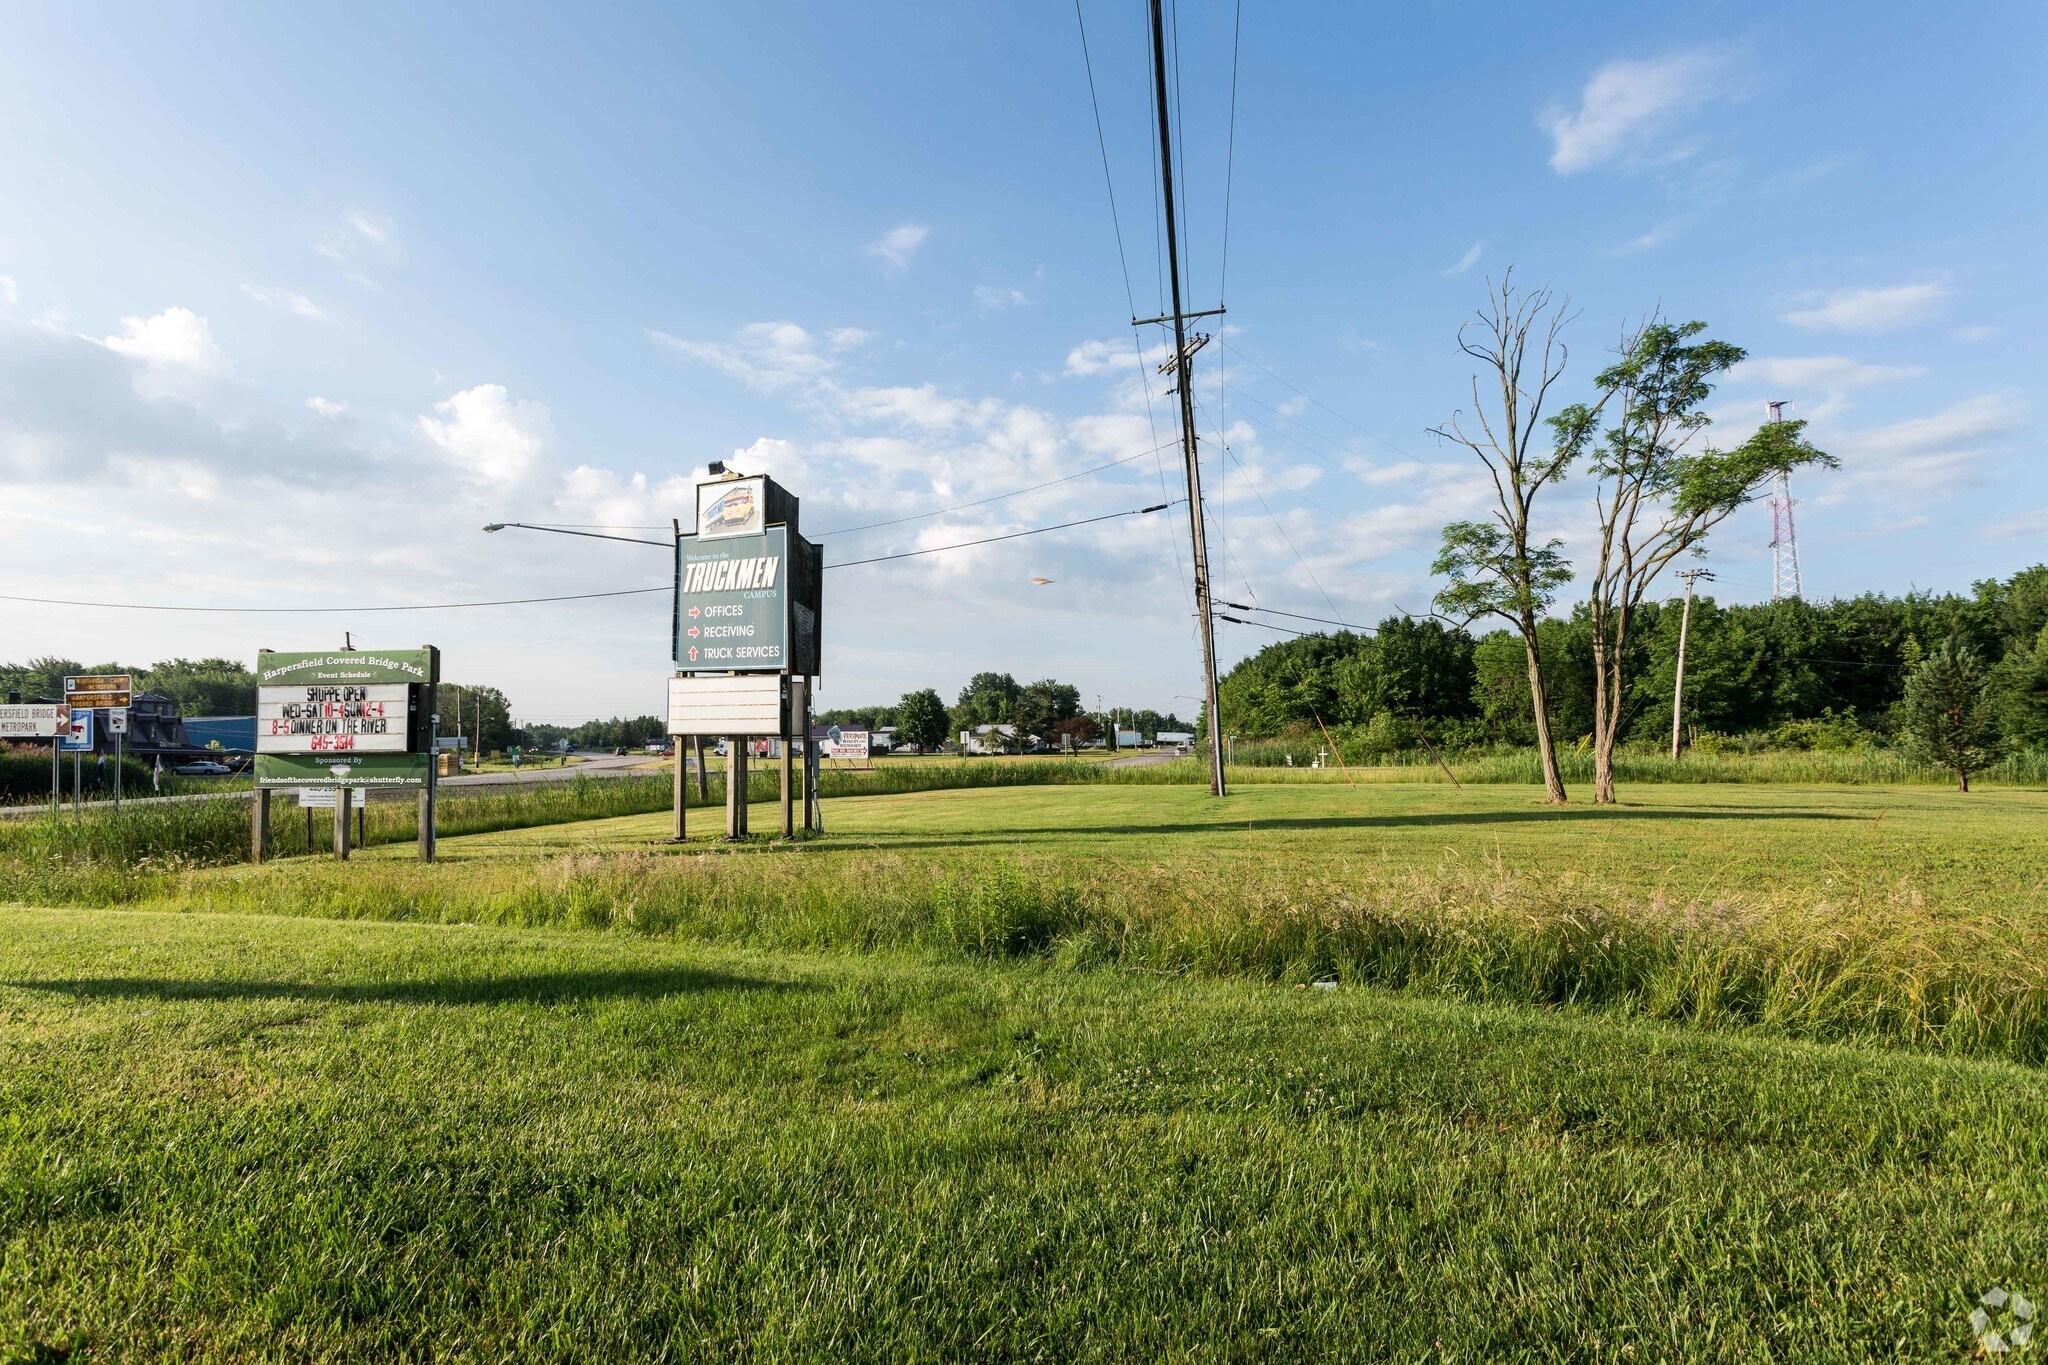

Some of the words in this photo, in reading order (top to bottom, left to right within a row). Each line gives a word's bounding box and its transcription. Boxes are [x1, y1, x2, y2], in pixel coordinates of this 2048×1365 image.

[683, 556, 779, 594] TRUCKMEN
[743, 590, 777, 599] CAMPUS
[704, 605, 743, 617] OFFICES
[703, 625, 754, 638] RECEIVING
[704, 647, 733, 659] TRUCK
[736, 646, 780, 658] SERVICES
[263, 658, 323, 681] Harpersfield
[326, 656, 366, 665] Covered
[368, 656, 399, 670] Bridge
[401, 662, 424, 677] Park
[343, 687, 366, 701] OPEN
[0, 708, 29, 719] ERSFIELD
[32, 708, 54, 719] BRIDGE
[1, 721, 37, 732] METROPARK
[271, 720, 290, 734] 8-5
[290, 719, 322, 734] DINNER
[325, 719, 337, 733] ON
[342, 719, 358, 733] THE
[361, 718, 387, 733] RIVER
[310, 735, 354, 750] 645-3514
[353, 757, 363, 765] By
[259, 776, 422, 785] friendsofthecoveredbridgepark@shutterfly.com
